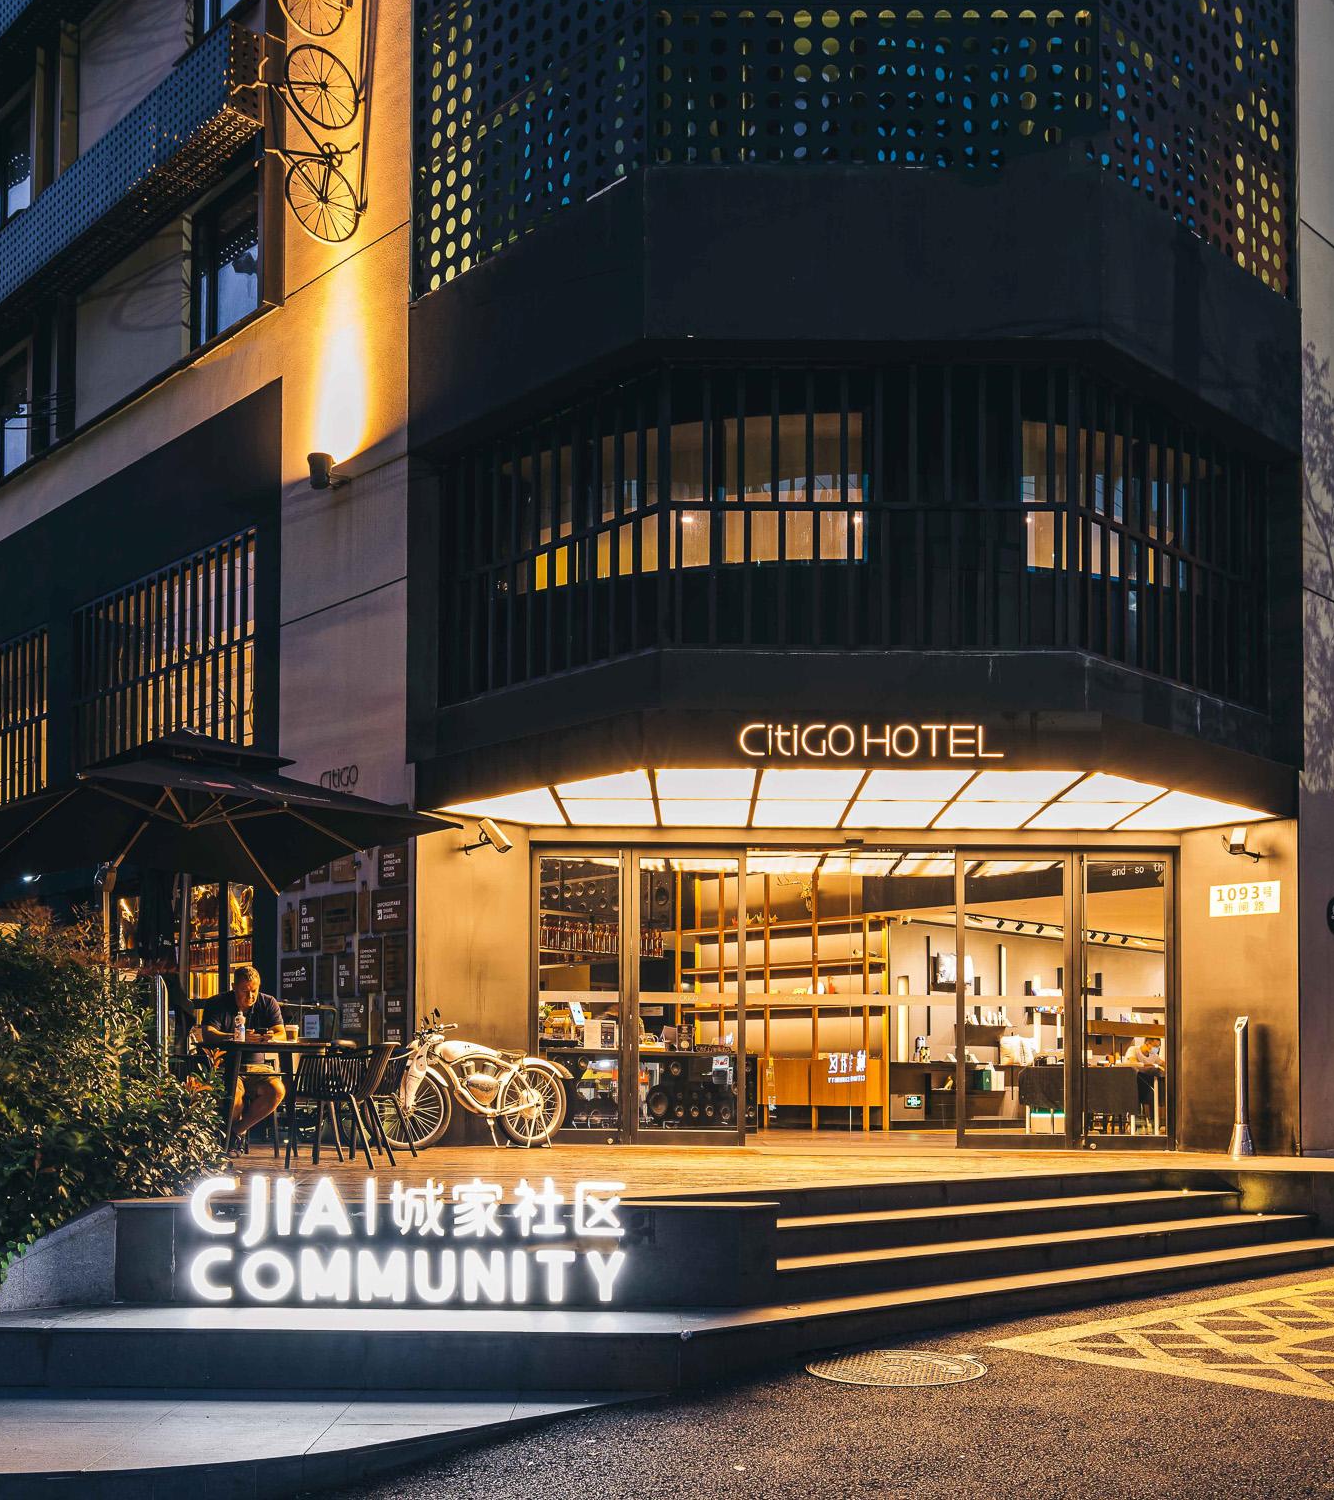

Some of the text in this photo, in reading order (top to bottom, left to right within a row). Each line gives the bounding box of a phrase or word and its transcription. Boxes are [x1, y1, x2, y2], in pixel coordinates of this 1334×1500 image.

[739, 723, 1005, 758] CitiGO HOTEL
[1111, 865, 1126, 877] and
[1134, 866, 1145, 874] so
[189, 1175, 353, 1247] CJIA
[389, 1176, 627, 1237] 城家社区
[189, 1246, 626, 1302] COMMUNITY
